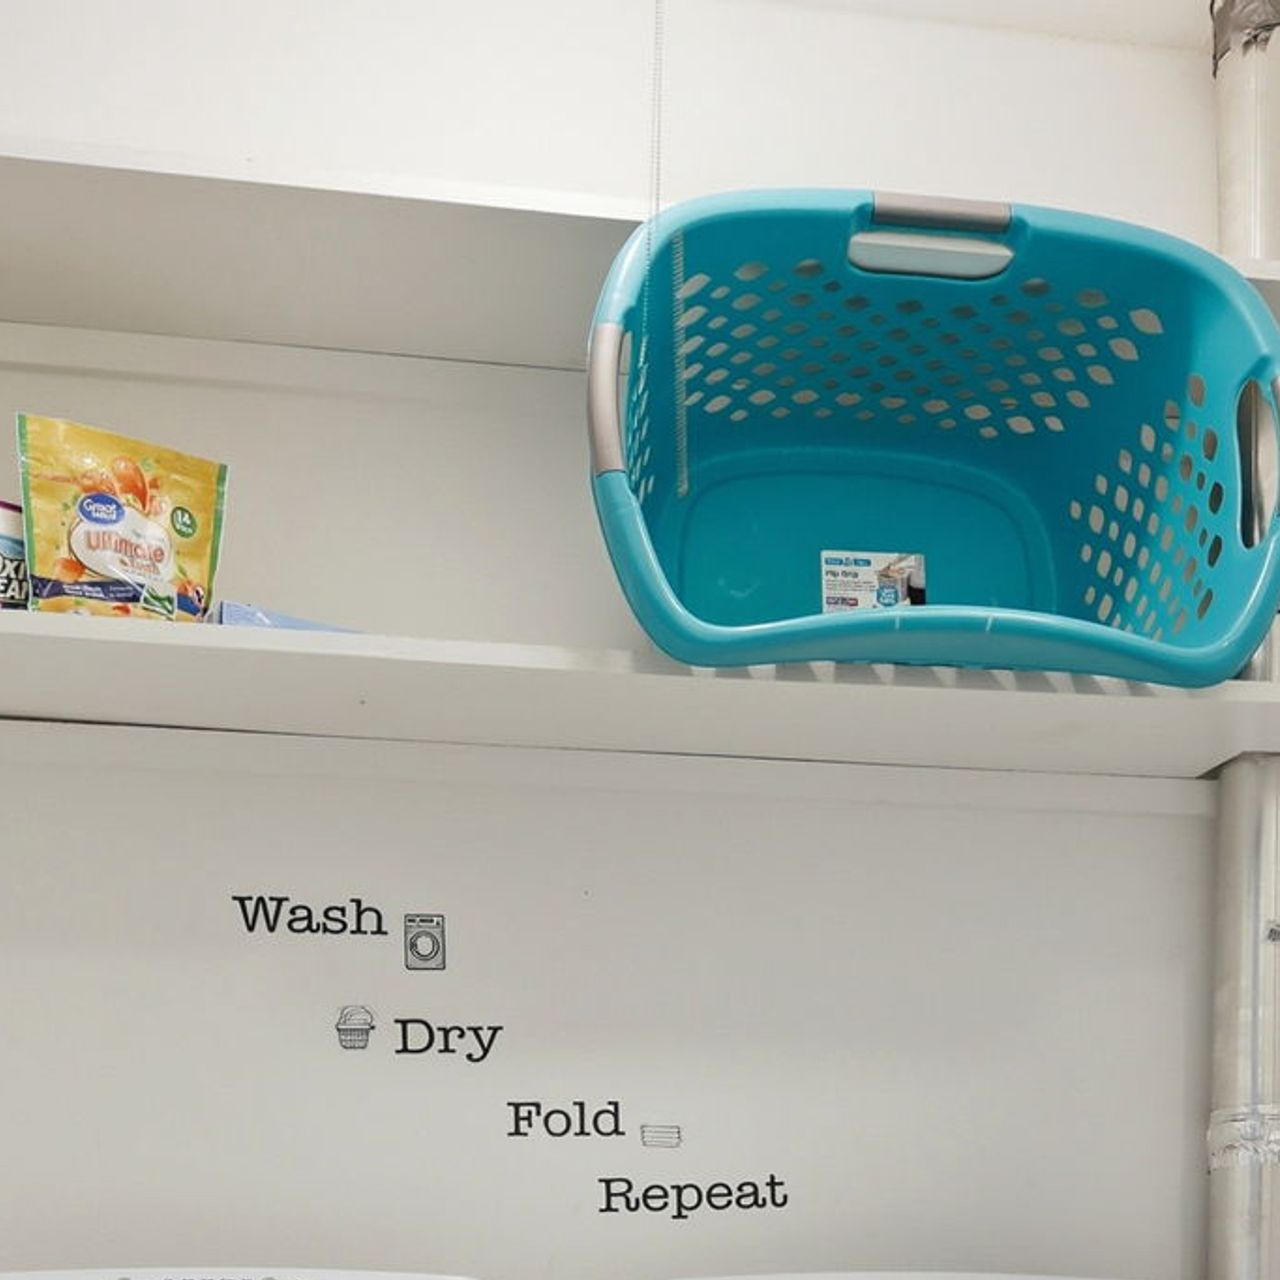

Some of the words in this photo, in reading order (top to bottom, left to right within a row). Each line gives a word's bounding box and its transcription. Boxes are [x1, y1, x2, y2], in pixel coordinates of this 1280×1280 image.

[232, 895, 388, 936] Wash
[394, 1018, 504, 1063] Dry
[506, 1100, 626, 1138] Fold
[598, 1173, 789, 1220] Repeat
